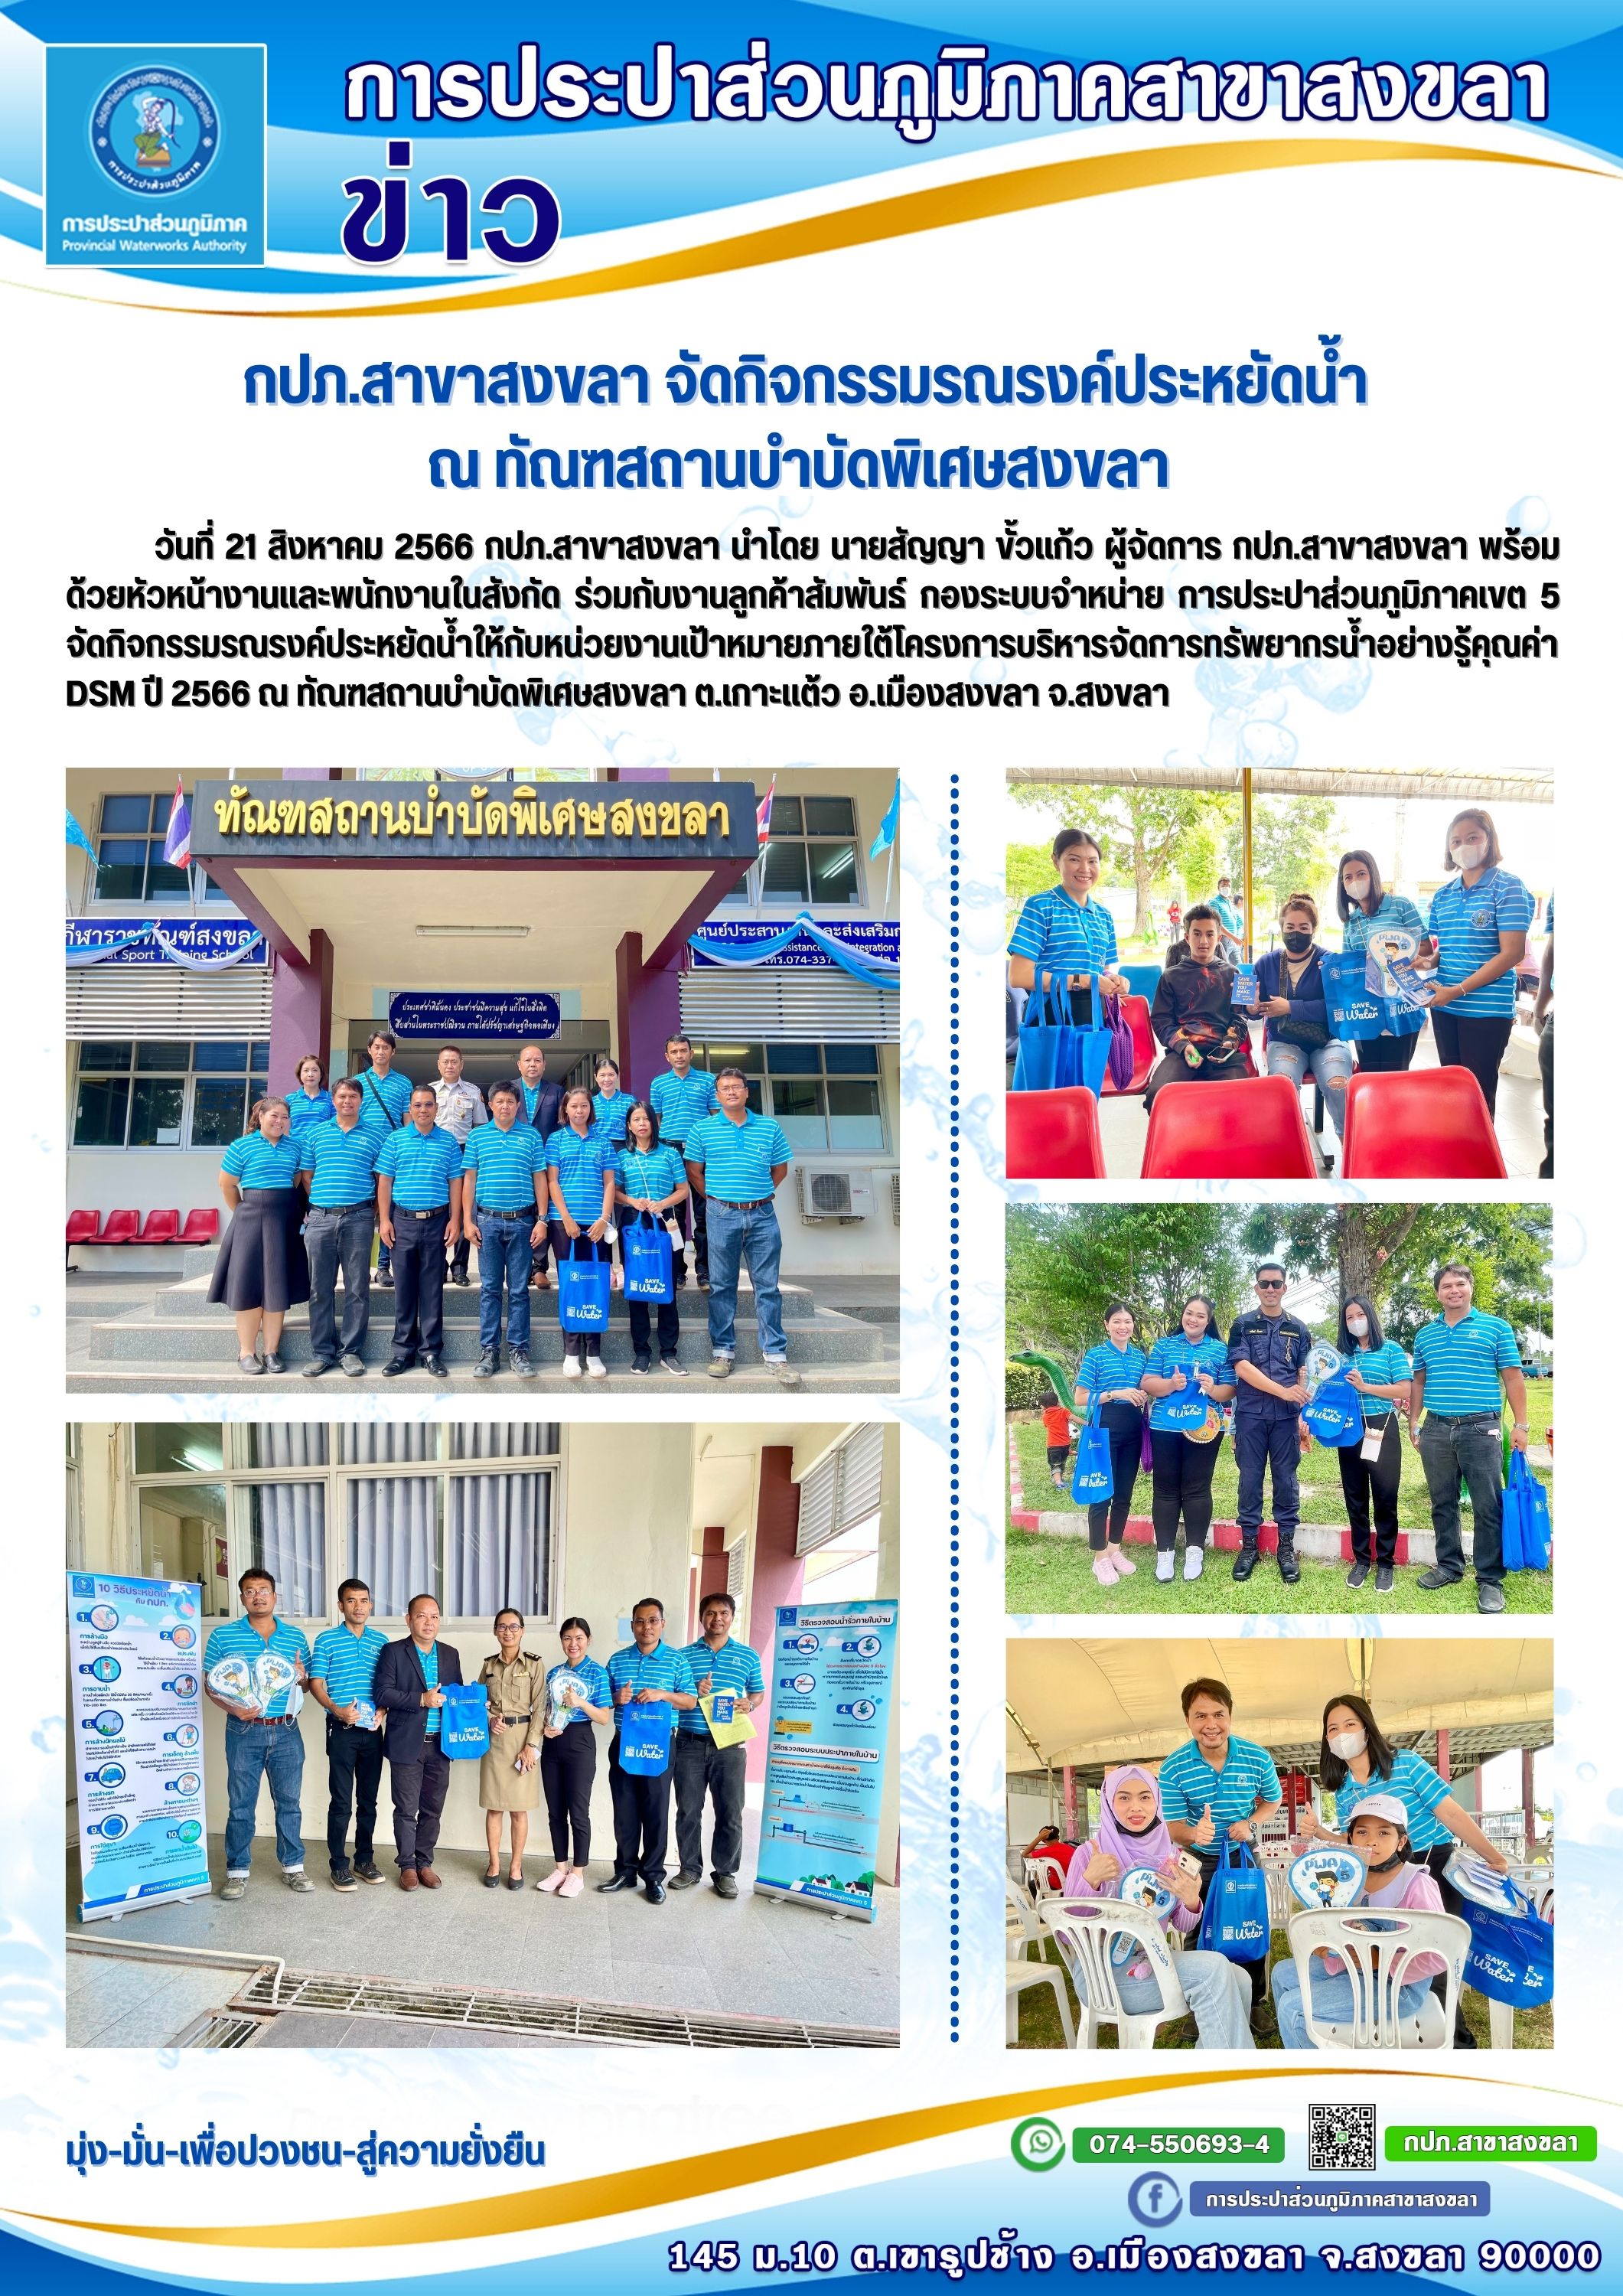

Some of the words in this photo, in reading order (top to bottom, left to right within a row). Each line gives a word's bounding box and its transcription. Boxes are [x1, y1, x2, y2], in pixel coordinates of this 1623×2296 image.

[214, 784, 729, 839] ทัณฑสถานบำบัดพิเศษสงขลา
[122, 949, 155, 962] Sport
[1346, 1008, 1378, 1021] Water
[639, 1283, 666, 1293] Water
[576, 1309, 602, 1319] Water
[1314, 1411, 1341, 1423] Water
[98, 1583, 110, 1593] 10
[458, 1733, 485, 1742] Water
[636, 1749, 663, 1759] Water
[1340, 1870, 1351, 1880] 5
[1158, 1896, 1166, 1906] 5
[1242, 1919, 1256, 1928] SAVE
[1235, 1926, 1263, 1940] Water
[1484, 1953, 1510, 1969] SAVE
[1474, 1955, 1514, 1983] Water
